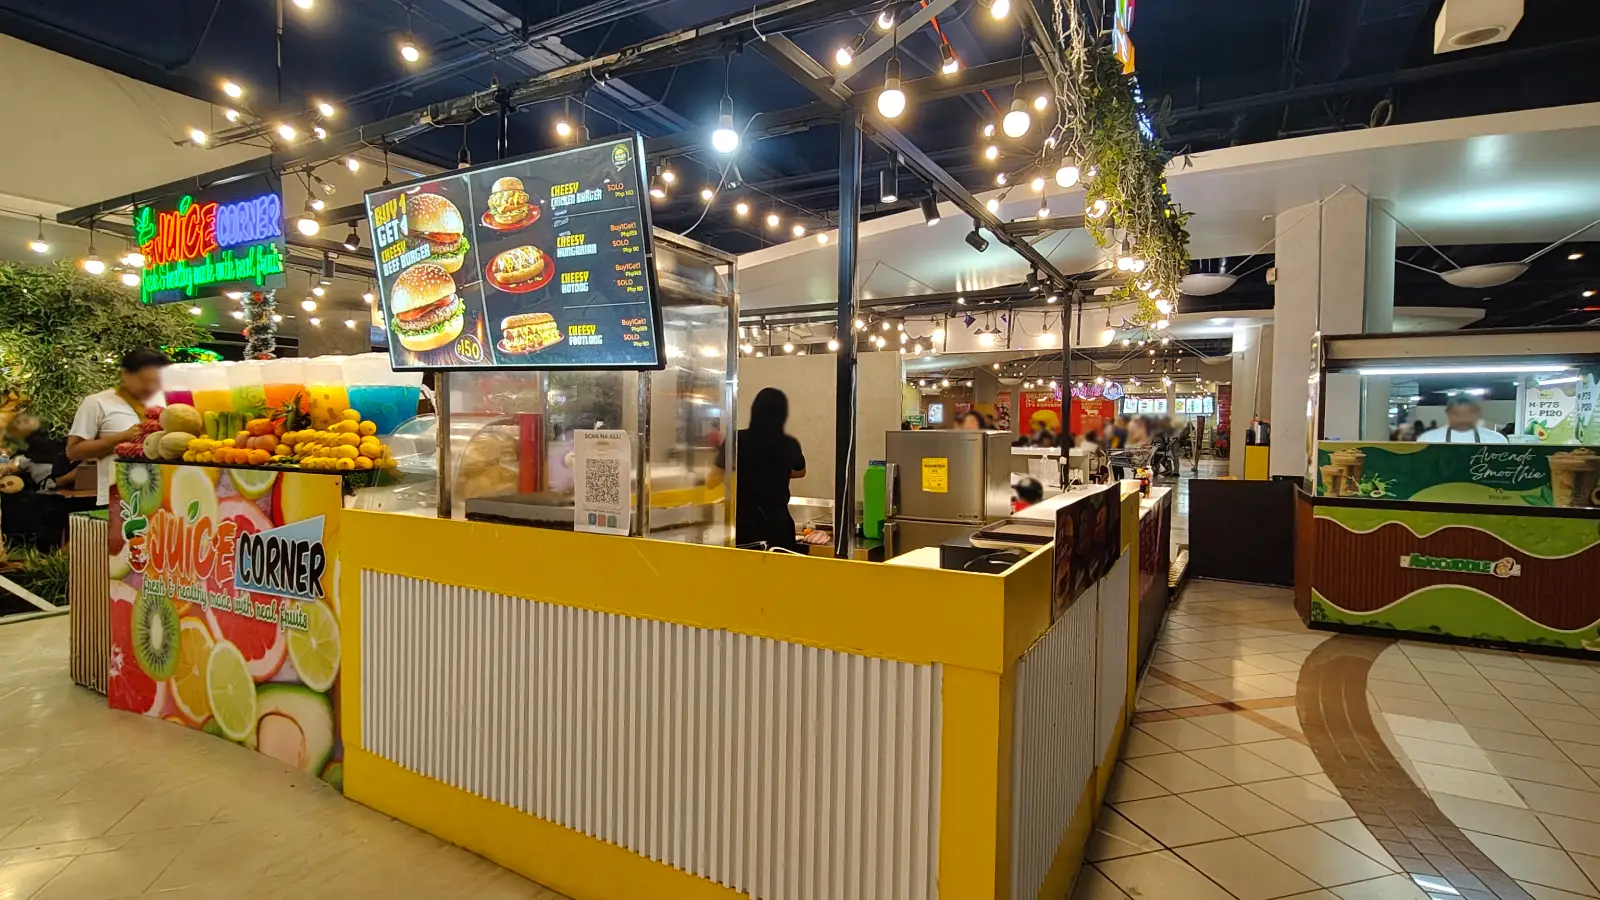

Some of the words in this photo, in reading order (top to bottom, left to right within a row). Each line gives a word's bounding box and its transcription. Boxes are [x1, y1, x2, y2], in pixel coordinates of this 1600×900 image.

[551, 182, 579, 197] CHEESY
[607, 183, 624, 191] SOLO
[374, 198, 397, 227] BUY
[399, 193, 406, 214] 1
[154, 196, 218, 265] JUICE
[217, 194, 281, 246] CORNER
[377, 219, 400, 248] GET
[400, 214, 408, 236] 1
[557, 234, 585, 248] CHEESY
[612, 239, 629, 247] SOLO
[381, 241, 406, 263] CHEESY
[557, 244, 597, 258] HUNGARIAN
[383, 261, 400, 277] BEEF
[400, 243, 431, 269] BURGER
[561, 271, 589, 284] CHEESY
[562, 282, 589, 294] HOTDOG
[568, 325, 596, 336] CHEESY
[624, 333, 639, 341] SOLO
[569, 335, 603, 346] FOOTLONG
[1470, 446, 1536, 464] Avocado
[1470, 463, 1544, 484] Smoothie
[151, 500, 237, 587] JUICE
[239, 530, 326, 598] CORNER
[143, 573, 166, 598] fresh
[168, 582, 175, 598] &
[177, 580, 208, 610] healthy
[210, 589, 231, 610] made
[234, 591, 253, 617] with
[256, 600, 277, 623] real
[280, 603, 308, 632] fruits
